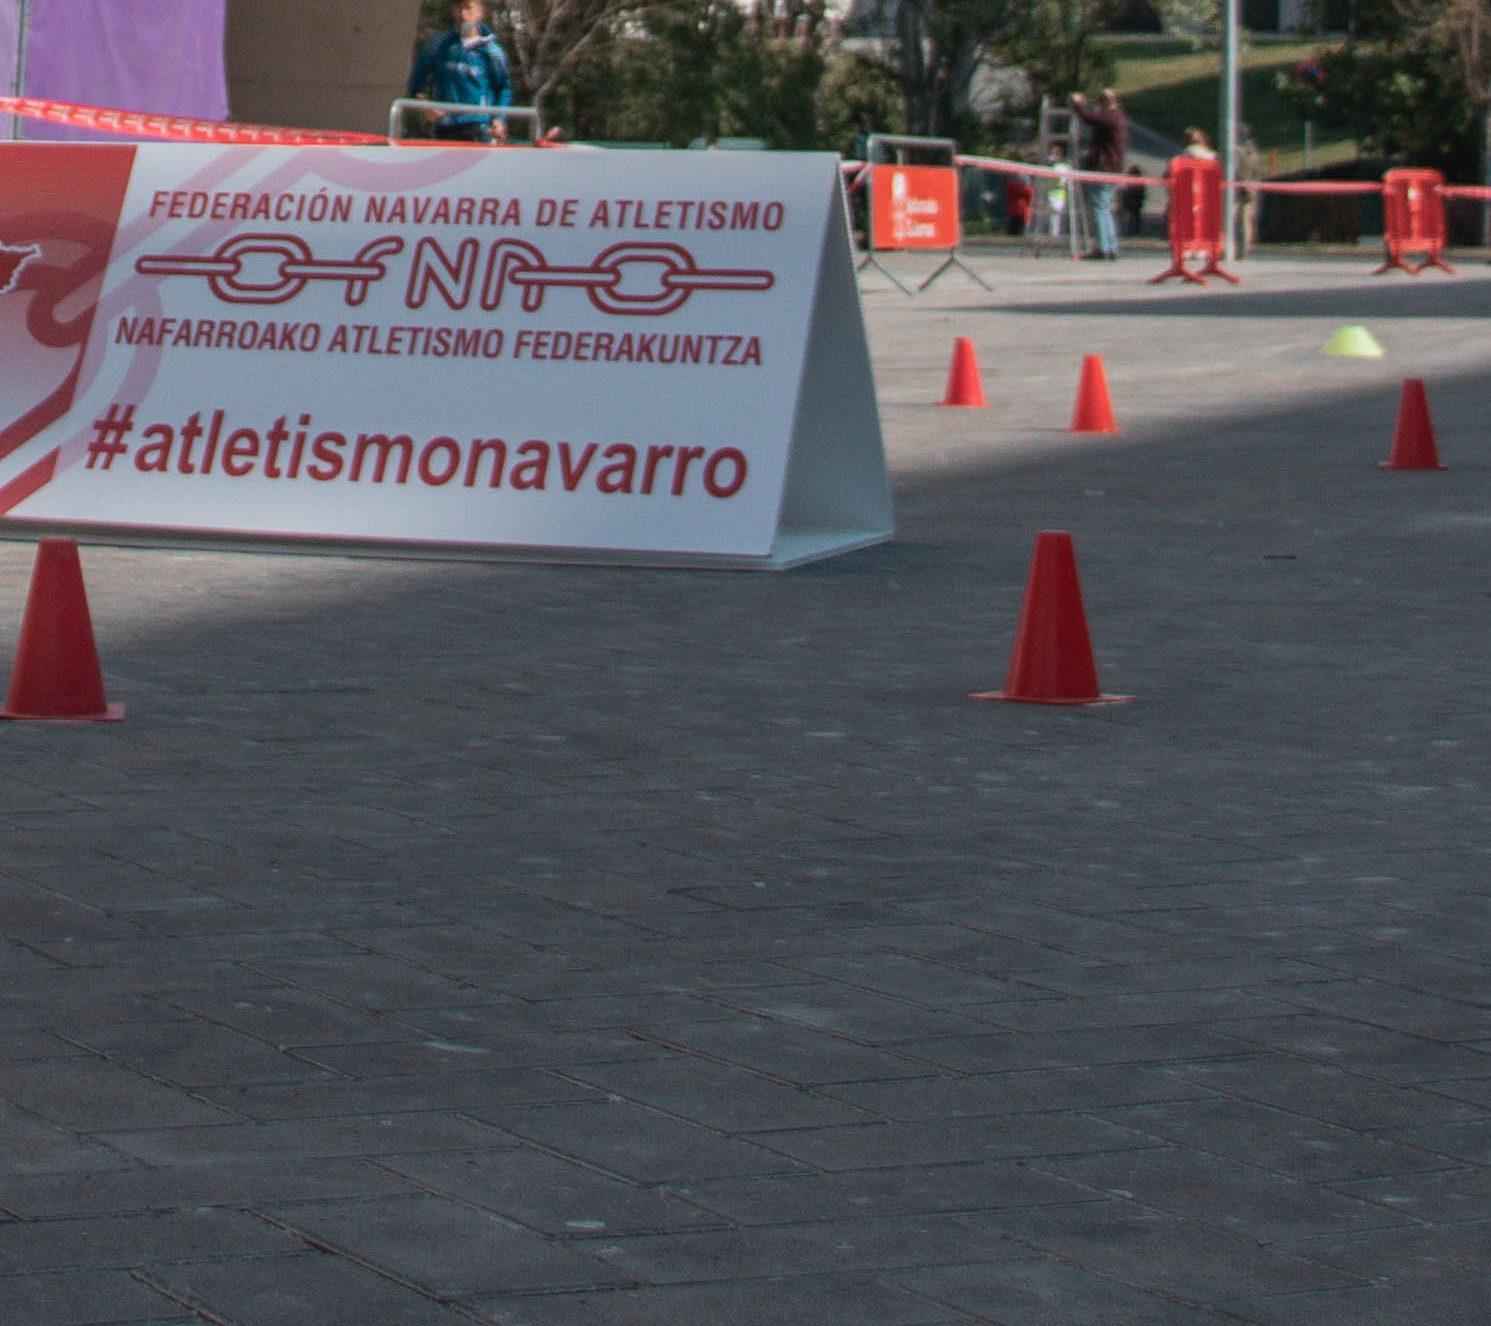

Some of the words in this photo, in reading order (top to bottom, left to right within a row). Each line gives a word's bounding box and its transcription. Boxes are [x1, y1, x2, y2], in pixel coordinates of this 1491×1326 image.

[148, 186, 354, 224] FEDERACIÓN
[365, 195, 522, 227] NAVARRA
[535, 198, 579, 228] DE
[588, 199, 785, 232] ATLETISMO
[115, 316, 321, 353] NAFARROAKO
[327, 323, 505, 360] ATLETISMO
[513, 329, 764, 366] FEDERAKUNTZA
[85, 403, 749, 499] #atletismonavarro
